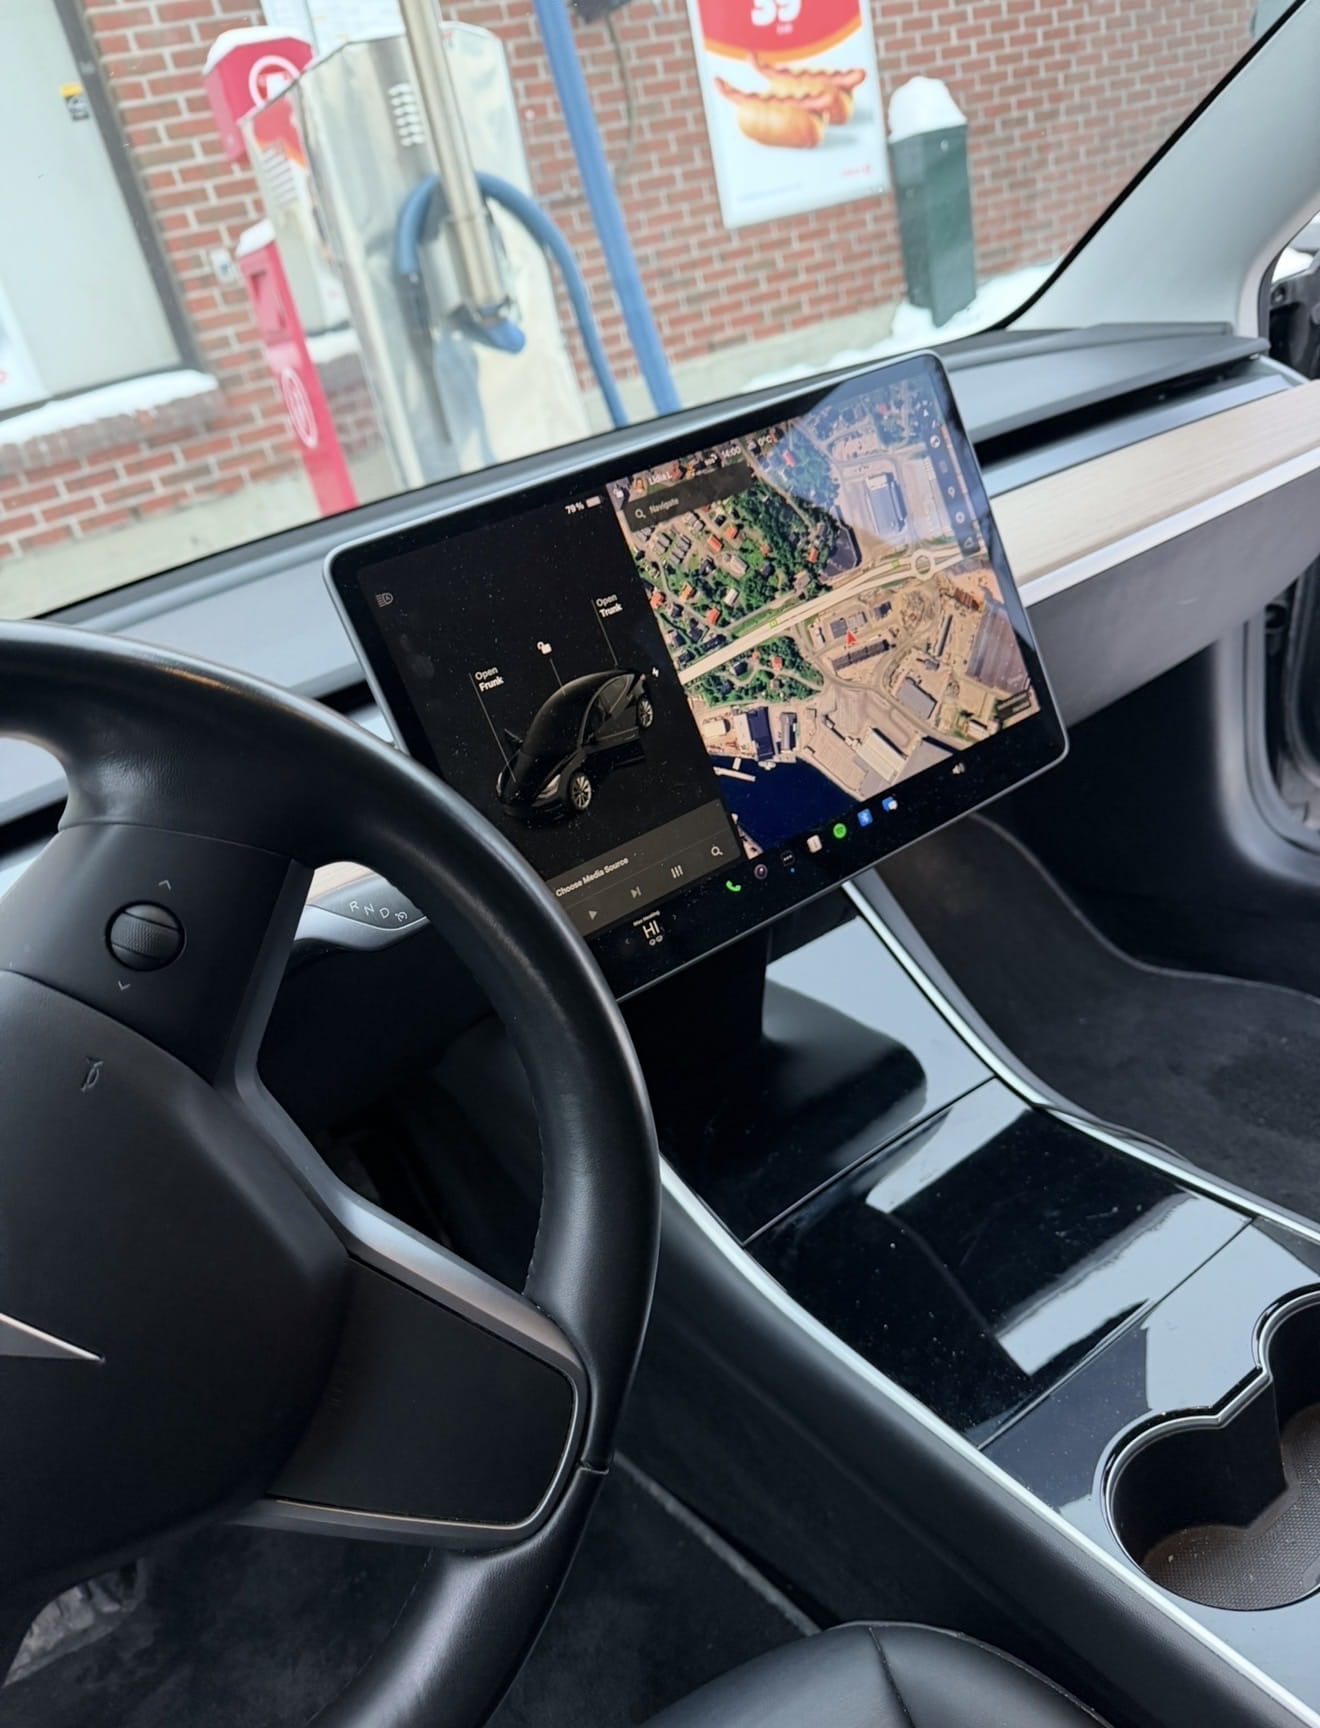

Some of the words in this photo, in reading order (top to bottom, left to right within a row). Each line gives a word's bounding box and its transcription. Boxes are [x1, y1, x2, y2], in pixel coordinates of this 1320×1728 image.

[649, 498, 679, 514] Navigate
[597, 594, 617, 607] Open
[600, 603, 623, 617] Trunk
[475, 667, 498, 681] Open
[479, 676, 504, 692] Frunk
[556, 880, 583, 897] Choose
[582, 869, 605, 884] Media
[604, 858, 629, 874] Source
[349, 900, 359, 912] R
[364, 903, 374, 916] N
[379, 907, 390, 919] D
[642, 920, 660, 939] HI
